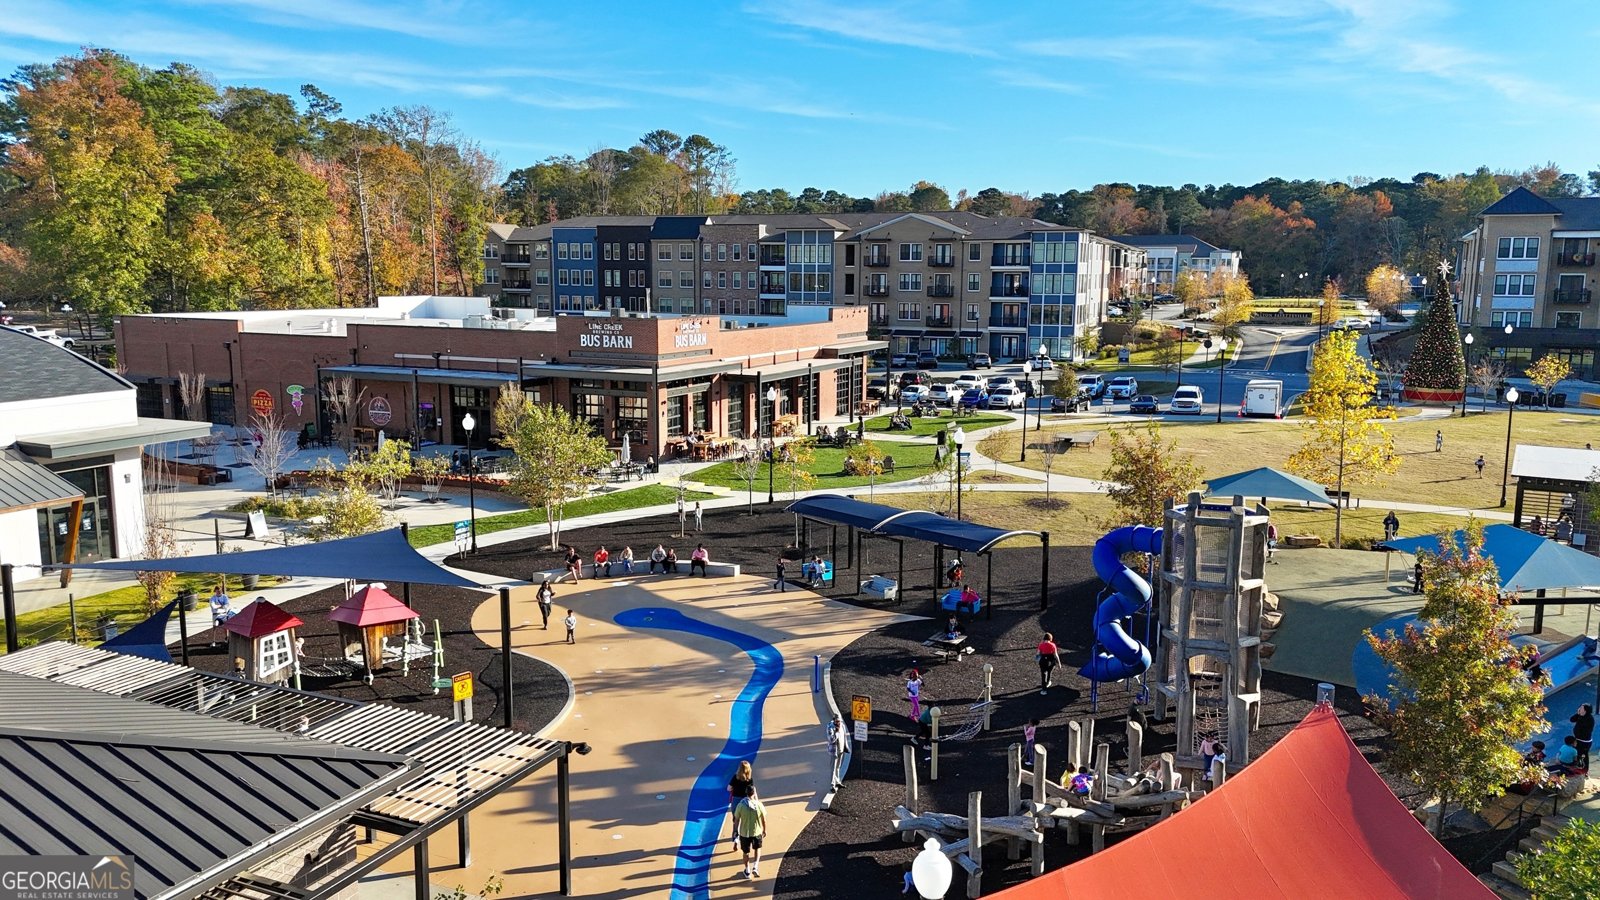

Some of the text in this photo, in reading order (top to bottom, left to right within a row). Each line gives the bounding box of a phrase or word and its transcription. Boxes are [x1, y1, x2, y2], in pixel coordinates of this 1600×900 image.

[603, 323, 623, 331] CREEK
[580, 334, 633, 349] BUS BARN
[675, 333, 707, 348] BUS BARN
[253, 399, 273, 407] PIZZA
